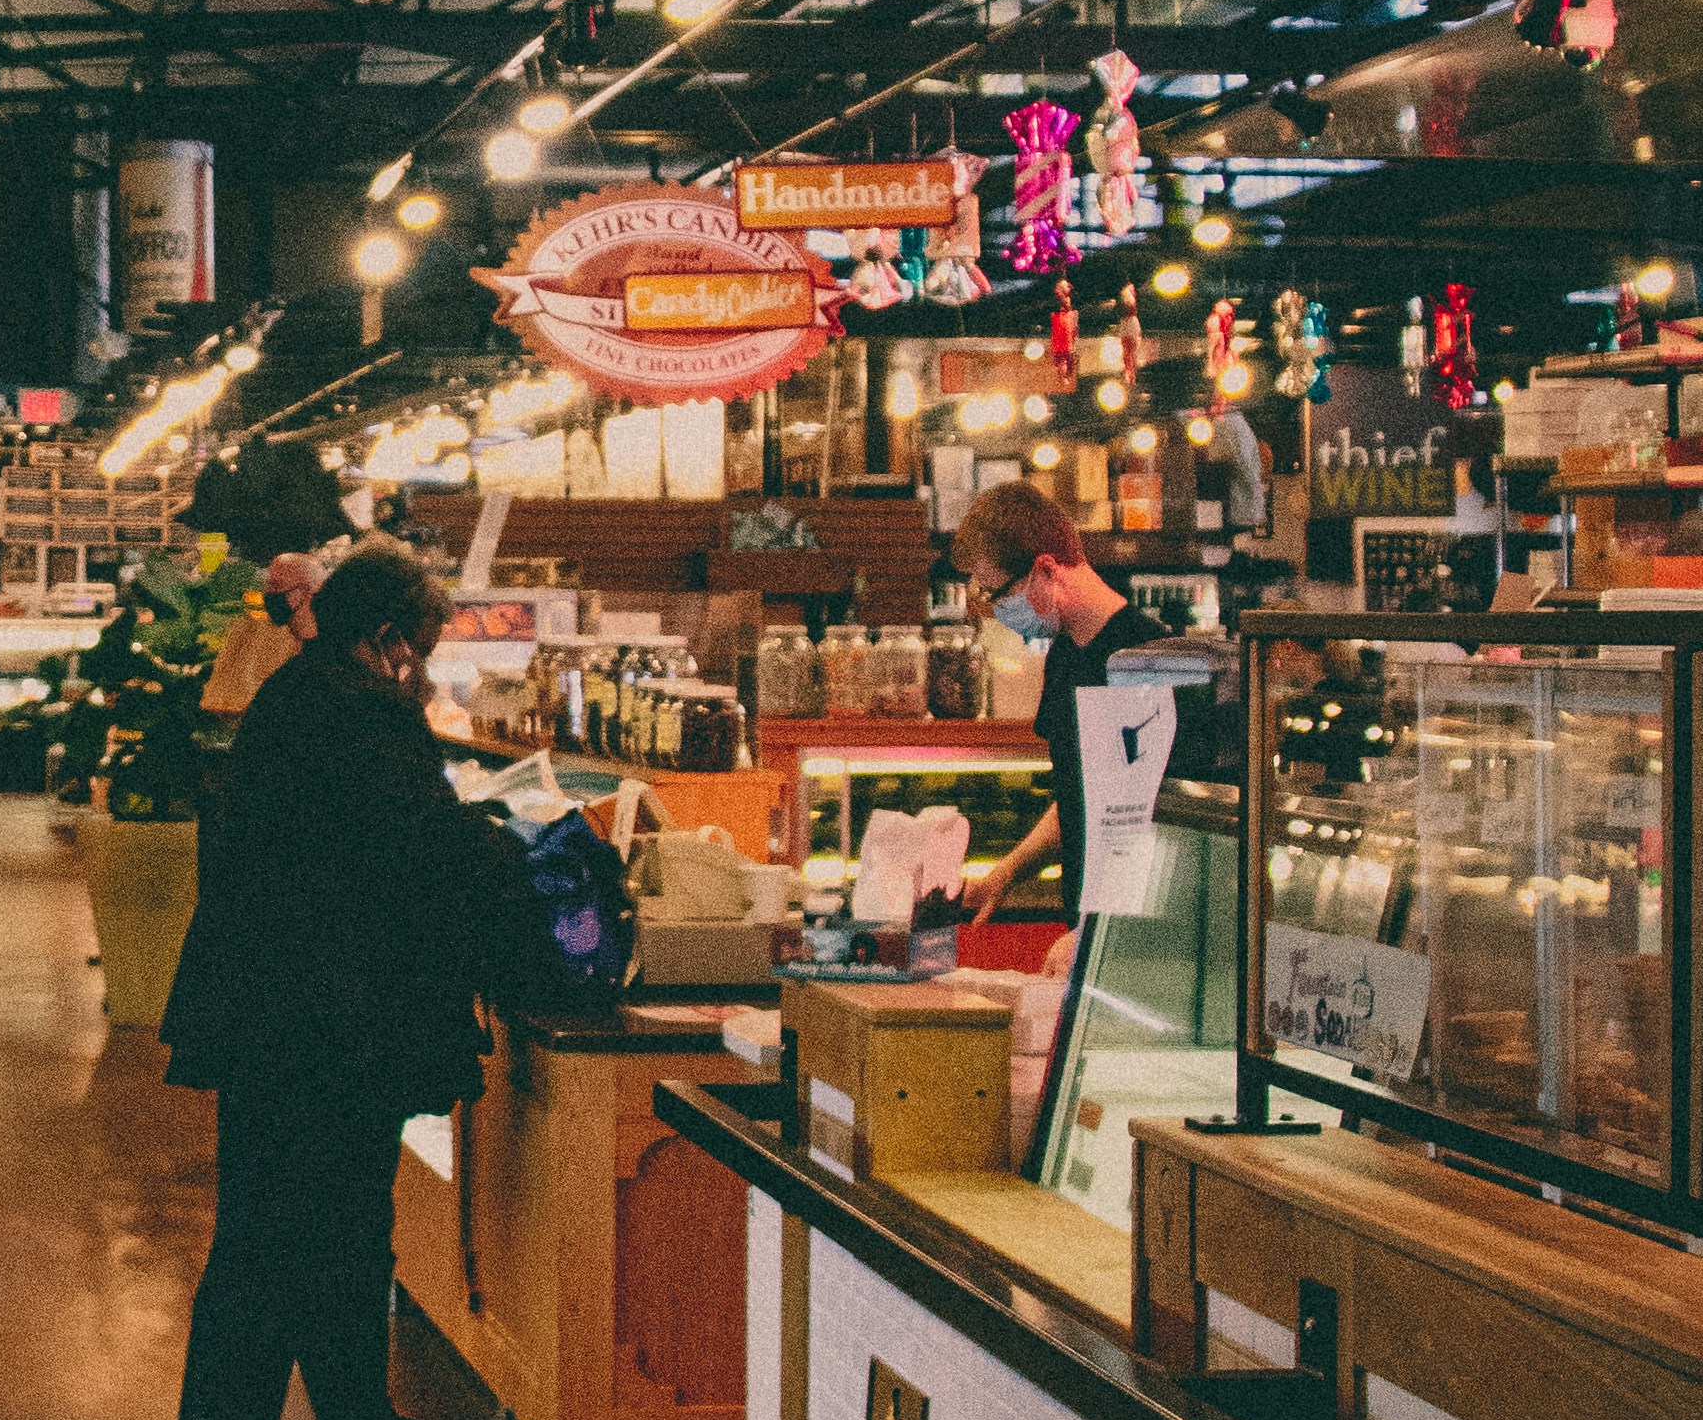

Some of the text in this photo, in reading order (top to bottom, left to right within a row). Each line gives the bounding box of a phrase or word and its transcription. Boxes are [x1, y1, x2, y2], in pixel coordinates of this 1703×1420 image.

[743, 168, 951, 213] Handmade
[553, 208, 656, 263] KEHR'S
[627, 281, 727, 325] Candy
[584, 337, 763, 372] FINE CHOCOLATES
[1317, 426, 1447, 467] thief
[1319, 468, 1446, 508] WINE
